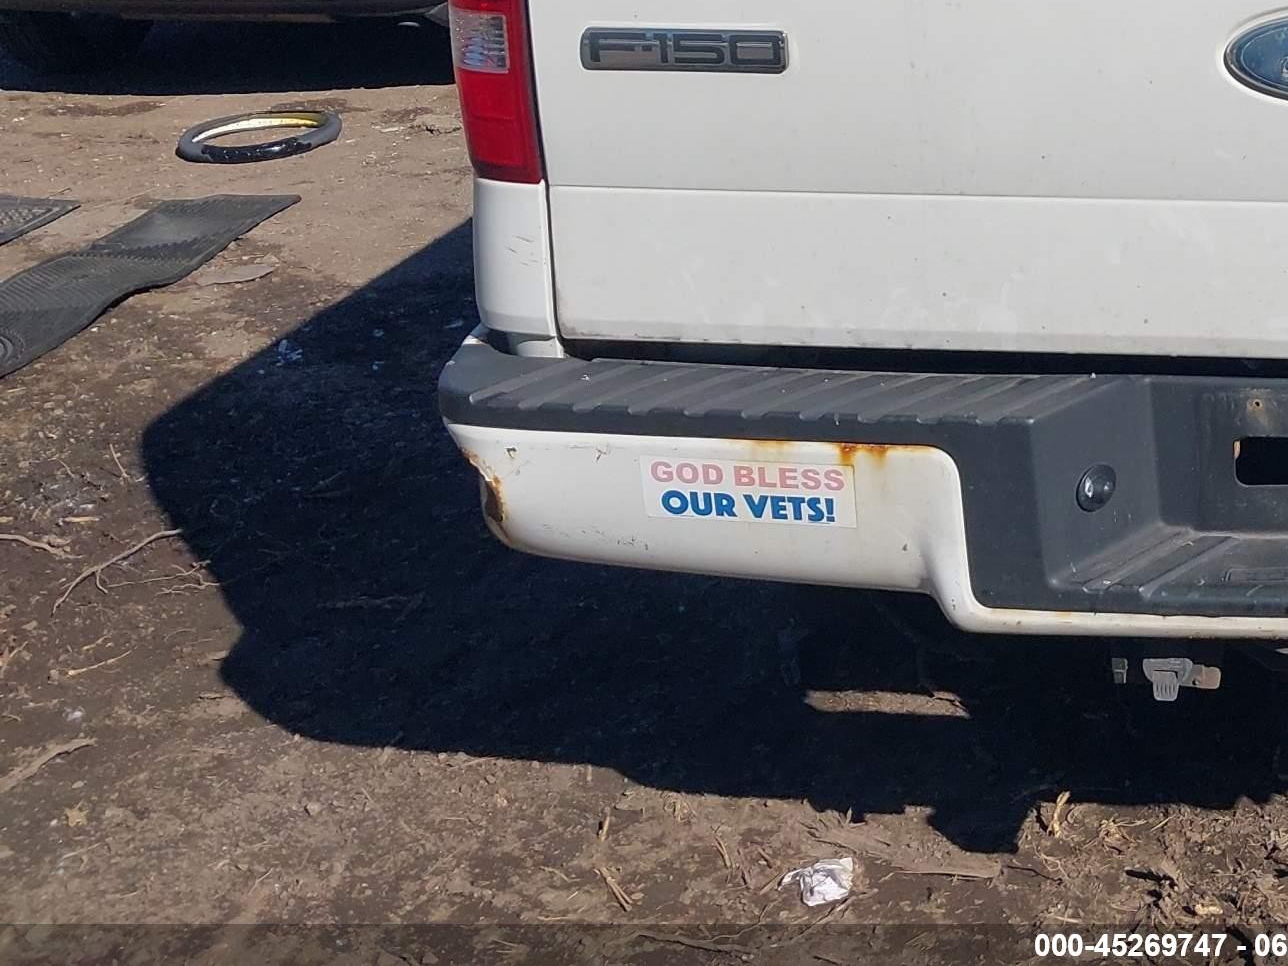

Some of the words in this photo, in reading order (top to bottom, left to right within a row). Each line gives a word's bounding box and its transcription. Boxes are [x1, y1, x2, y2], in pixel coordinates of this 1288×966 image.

[589, 32, 782, 66] F-150
[650, 461, 723, 485] GOD
[734, 465, 845, 491] BLESS
[661, 490, 738, 517] OUR
[743, 494, 836, 523] VETS!
